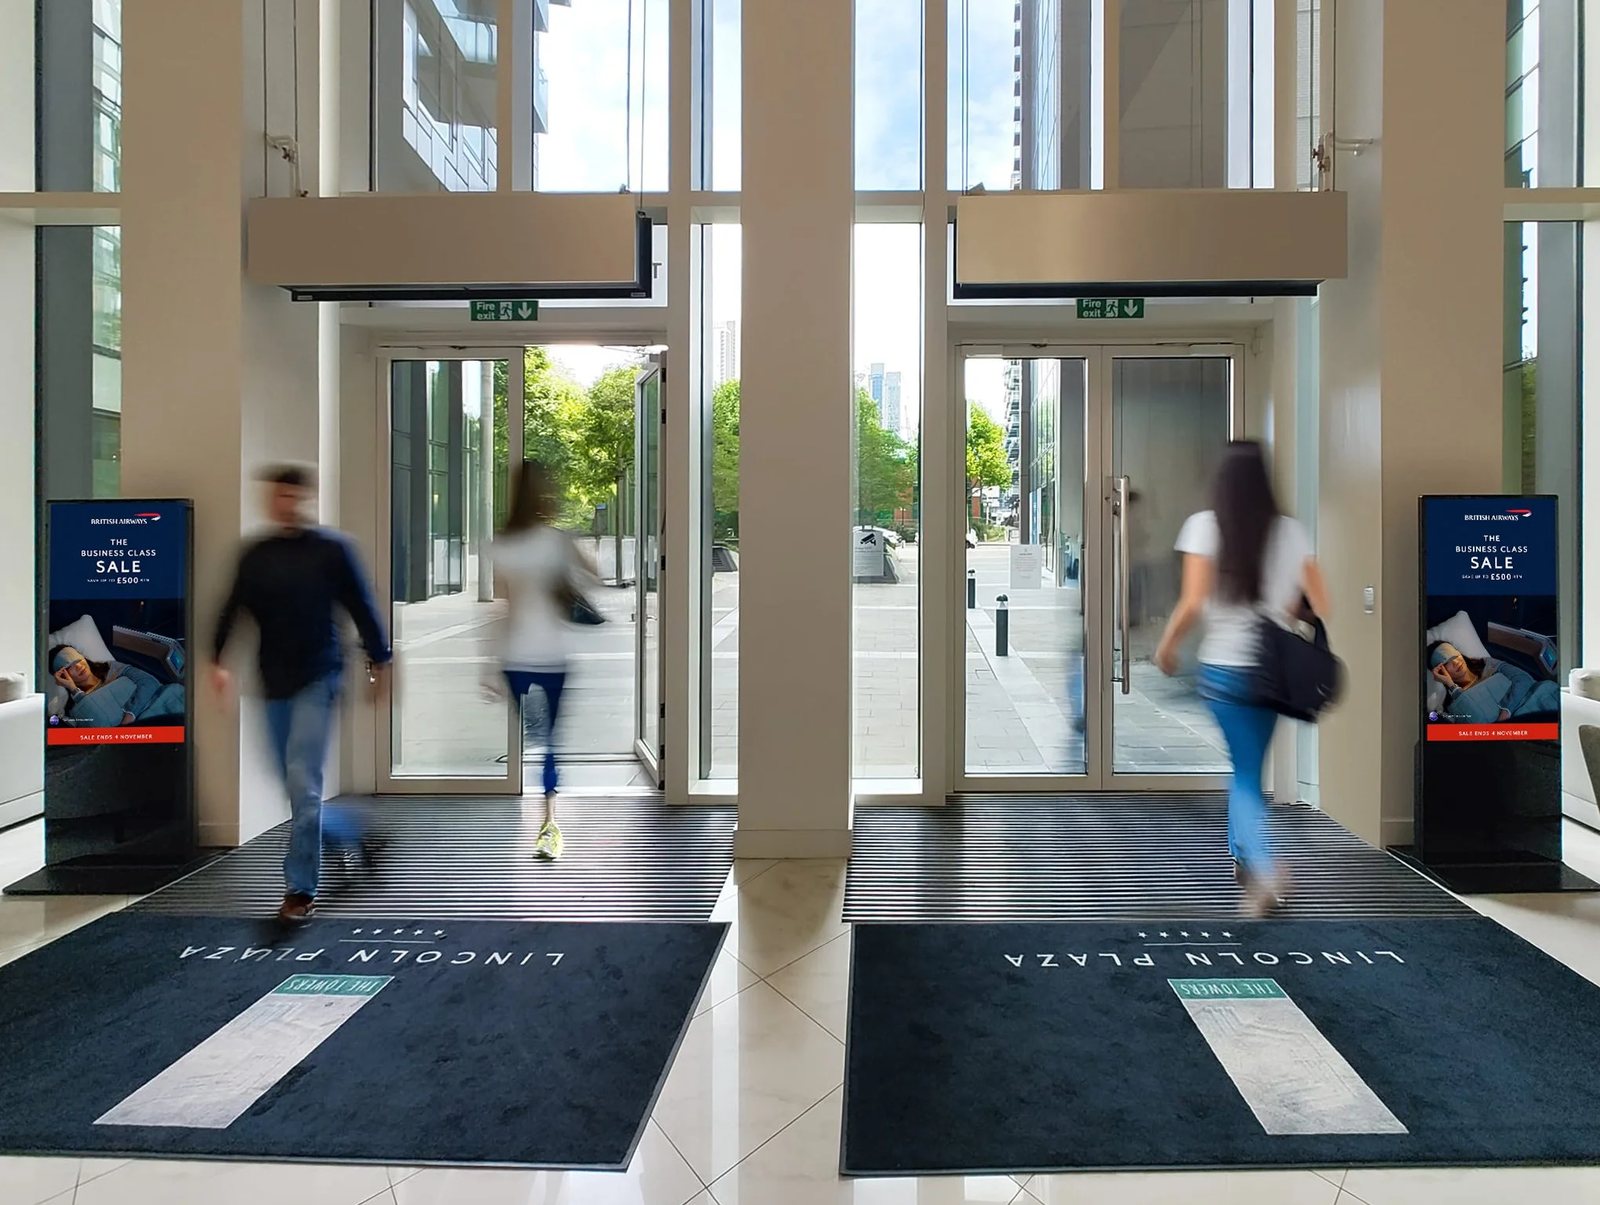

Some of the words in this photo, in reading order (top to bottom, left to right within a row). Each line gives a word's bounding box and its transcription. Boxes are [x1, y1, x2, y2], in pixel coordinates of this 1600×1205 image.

[476, 301, 496, 311] Fire
[1082, 299, 1102, 309] Fire
[476, 311, 496, 320] exit
[1082, 308, 1102, 318] exit
[110, 538, 128, 546] THE
[1483, 534, 1501, 542] THE
[80, 549, 124, 557] BUSINESS
[127, 549, 157, 557] CLASS
[1455, 545, 1497, 553] BUSINESS
[1500, 545, 1528, 553] CLASS
[96, 560, 141, 574] SALE
[1470, 556, 1514, 569] SALE
[116, 576, 139, 584] £500
[1490, 573, 1512, 581] £500
[179, 946, 325, 964] PLAZA
[347, 949, 565, 966] LINCOLN
[1003, 953, 1156, 968] PLAZA
[1184, 951, 1406, 967] LINCOLN
[284, 979, 348, 992] TOWERS
[347, 979, 381, 993] THE
[1179, 982, 1242, 996] TOWERS
[1242, 982, 1277, 995] THE
